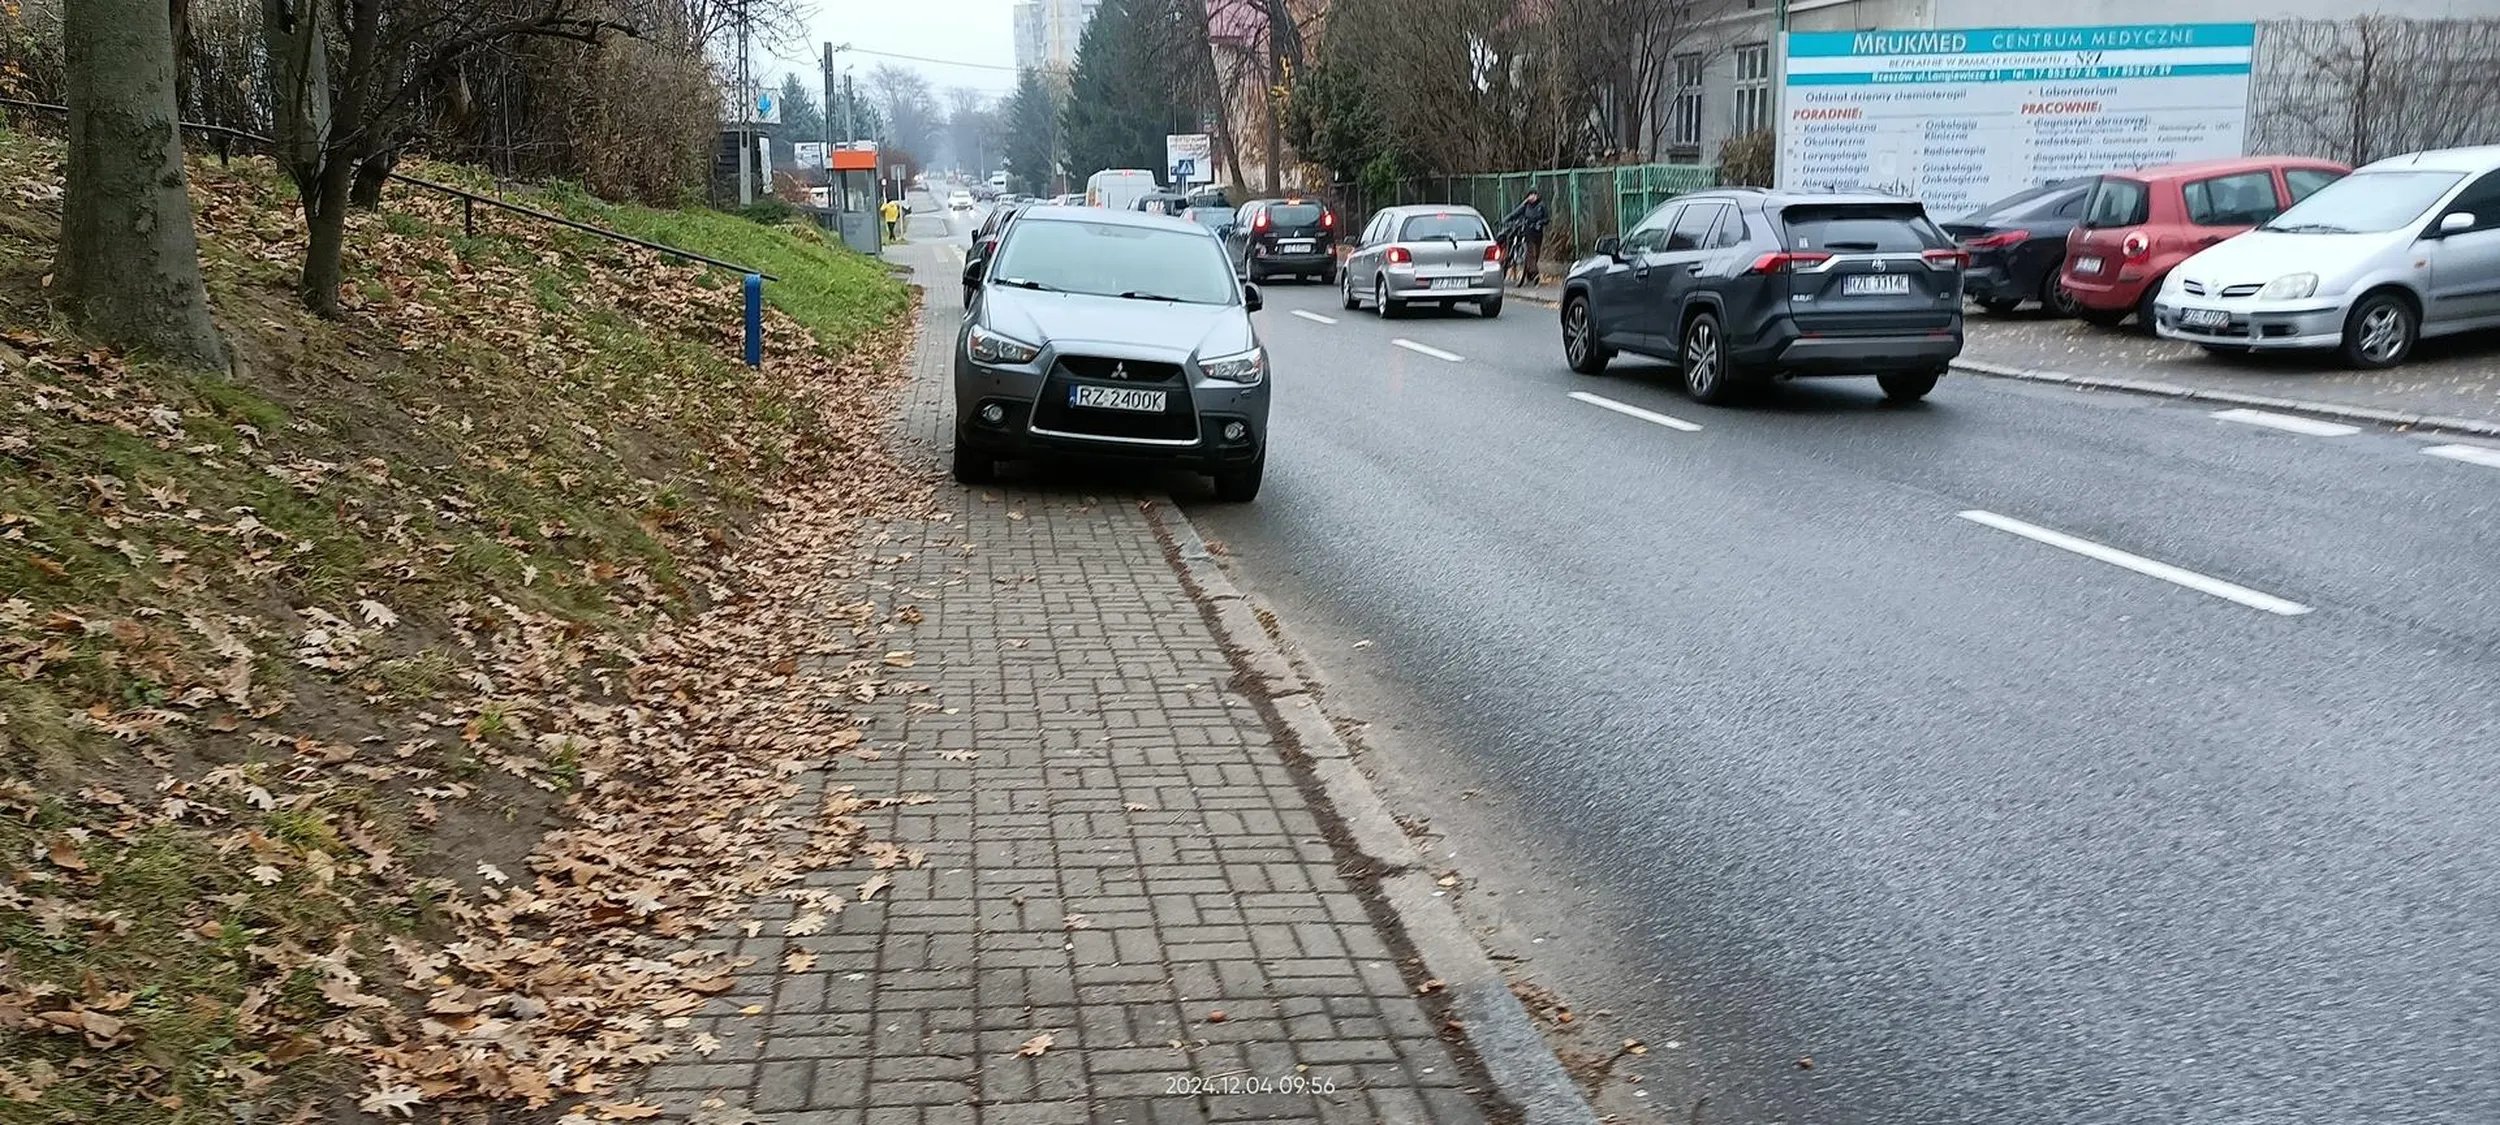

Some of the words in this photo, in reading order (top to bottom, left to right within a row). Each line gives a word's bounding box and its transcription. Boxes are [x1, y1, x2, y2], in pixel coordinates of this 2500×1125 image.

[1992, 31, 2082, 49] CENTRUM
[2091, 28, 2194, 46] MEDYCZNE
[1872, 71, 1913, 83] Rzeszów
[2039, 86, 2118, 98] Laboratorium
[1792, 107, 1863, 121] PORADNIE:
[2020, 101, 2102, 115] PRACOWNIE:
[1804, 121, 1878, 134] Kardiologiczna
[1925, 120, 1978, 131] Onkologia
[1923, 145, 1987, 158] Radioterapia
[1920, 190, 1968, 201] Chirurgia
[1080, 387, 1104, 406] RZ
[1110, 388, 1163, 411] 2400K
